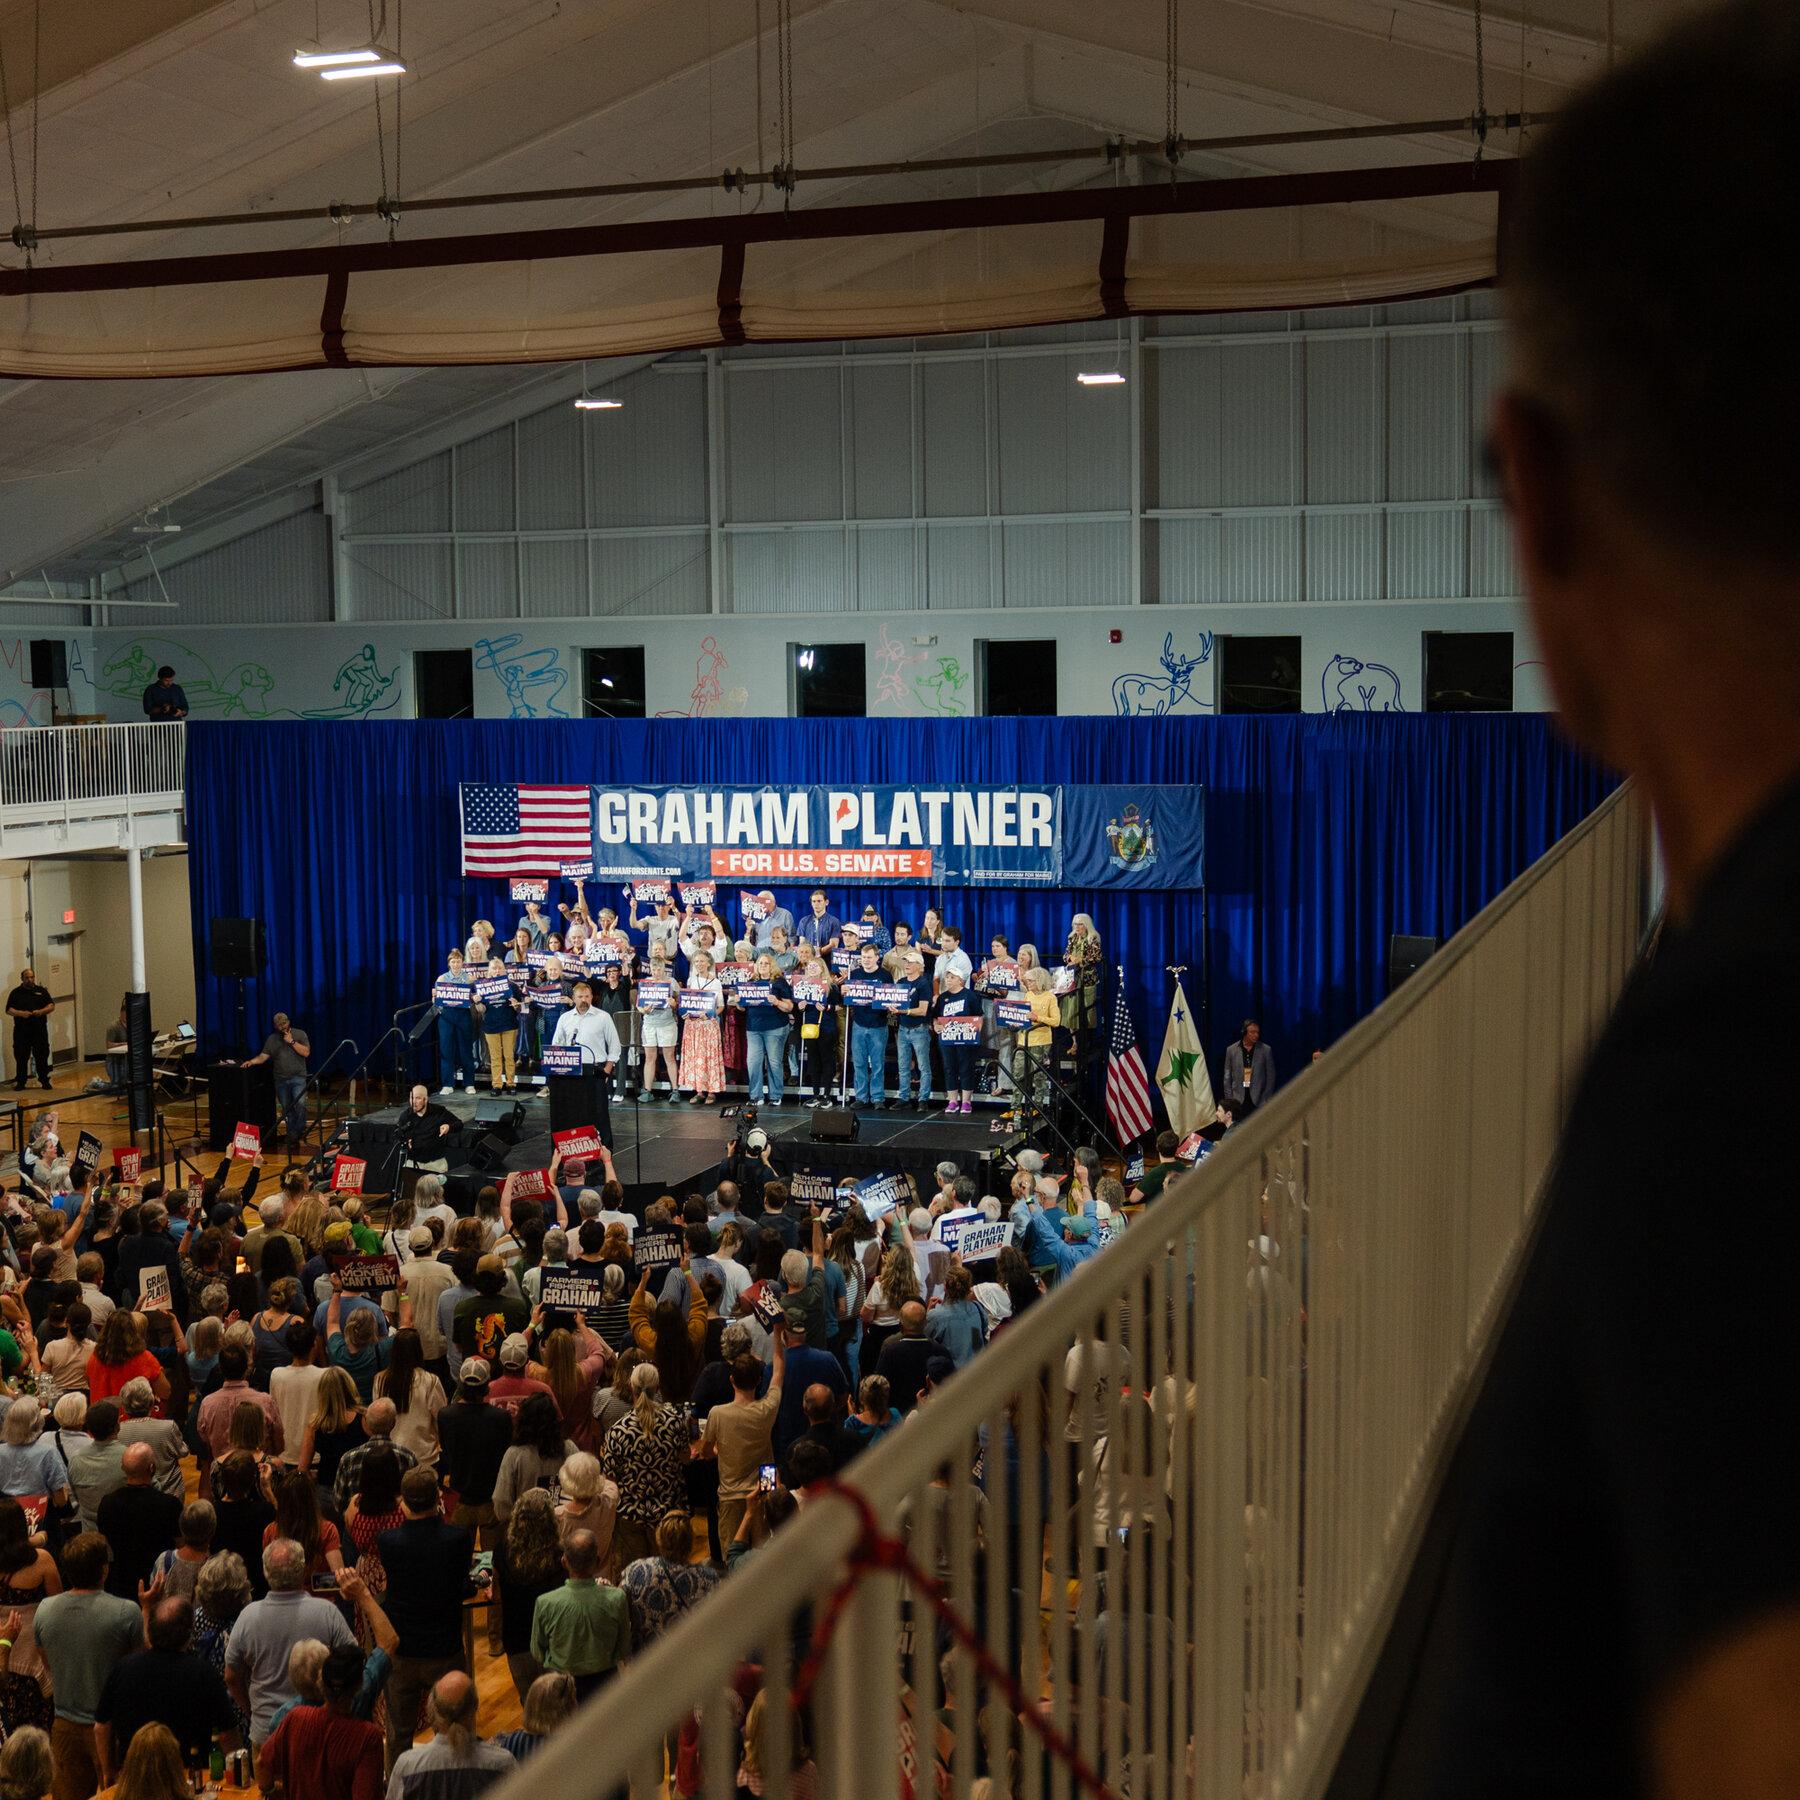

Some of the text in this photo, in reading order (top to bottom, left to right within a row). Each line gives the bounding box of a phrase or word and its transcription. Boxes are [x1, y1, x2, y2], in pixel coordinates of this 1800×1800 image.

[600, 792, 1052, 847] GRAHAM PLATNER
[729, 853, 912, 873] FOR U.S. SENATE
[561, 866, 593, 876] MAINE
[600, 866, 682, 876] GRAHAMFORSENATE.COM
[476, 983, 510, 996] MAINE
[846, 989, 874, 997] MAIN
[437, 991, 470, 1000] MAINE
[875, 992, 908, 1001] MAINE
[681, 1000, 713, 1009] MAINE
[543, 1056, 580, 1066] MAINE
[558, 1139, 600, 1156] GRAHAM
[964, 1225, 1006, 1244] GRAHAM
[963, 1234, 1004, 1254] PLATNER
[340, 1268, 394, 1278] MONEY
[342, 1275, 396, 1286] CAN'T BUY
[543, 1288, 600, 1306] GRAHAM
